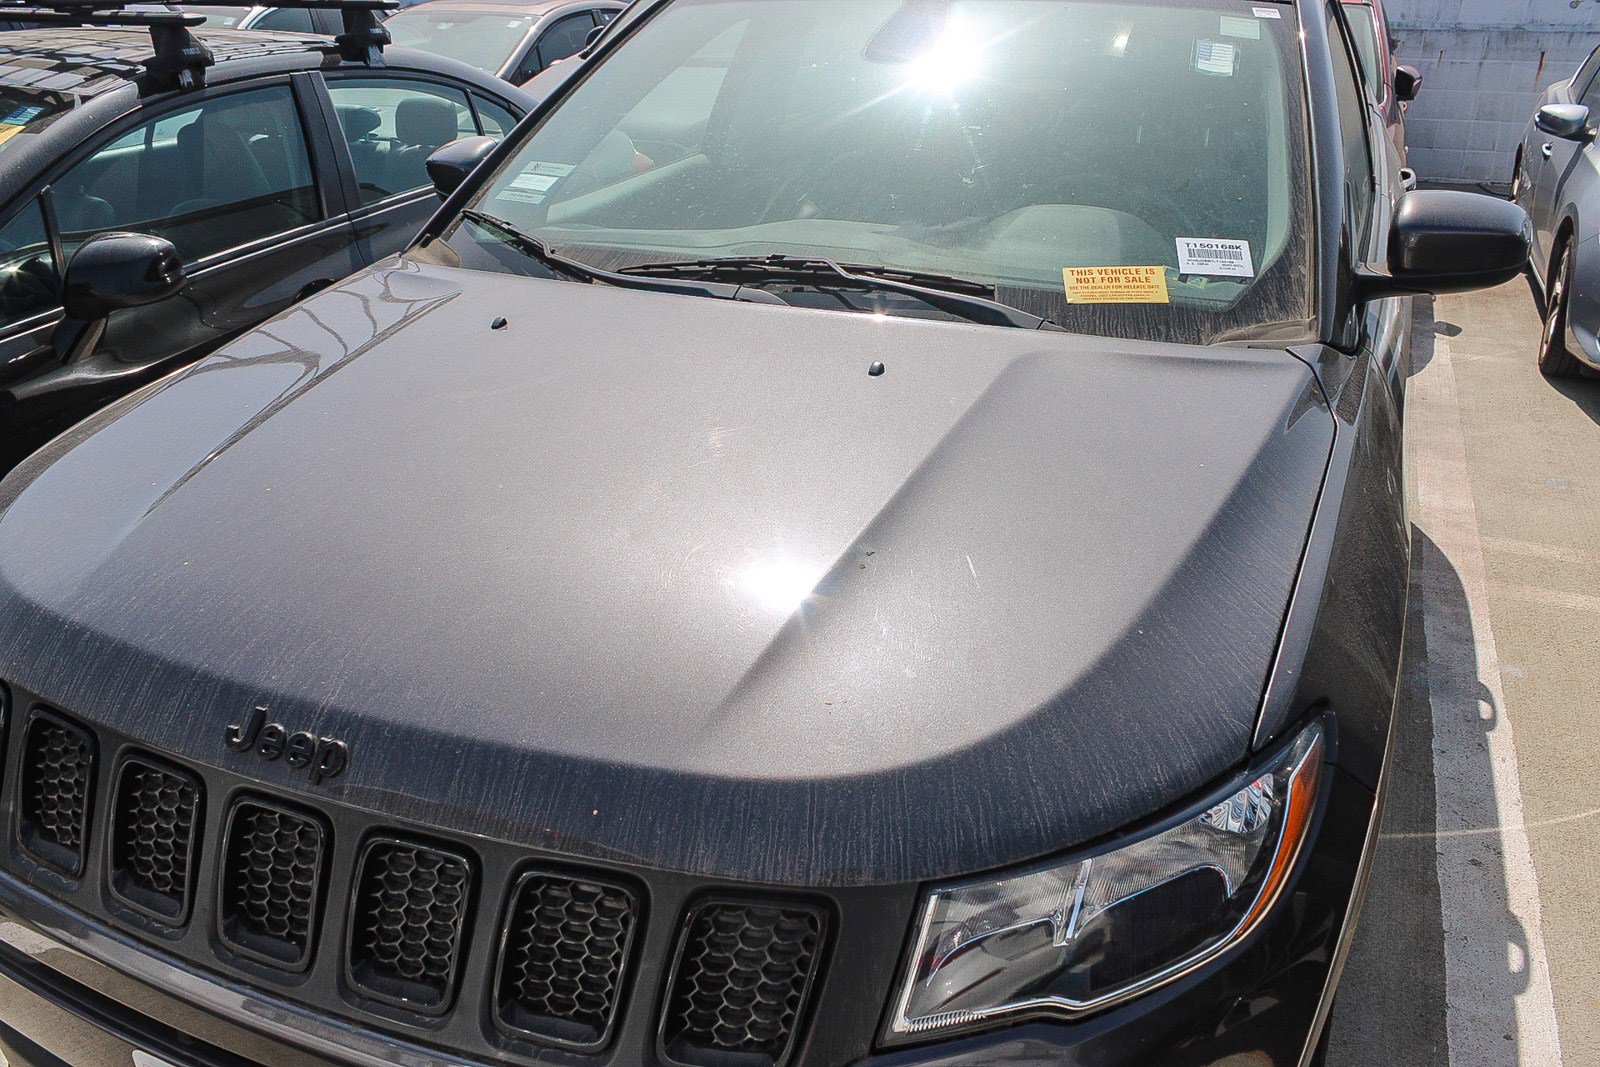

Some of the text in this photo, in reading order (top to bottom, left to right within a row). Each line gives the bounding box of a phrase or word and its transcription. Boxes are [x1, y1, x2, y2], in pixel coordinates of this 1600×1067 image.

[1097, 268, 1141, 276] VEHICLE
[1101, 276, 1121, 284] FOR
[225, 706, 348, 786] Jeep
